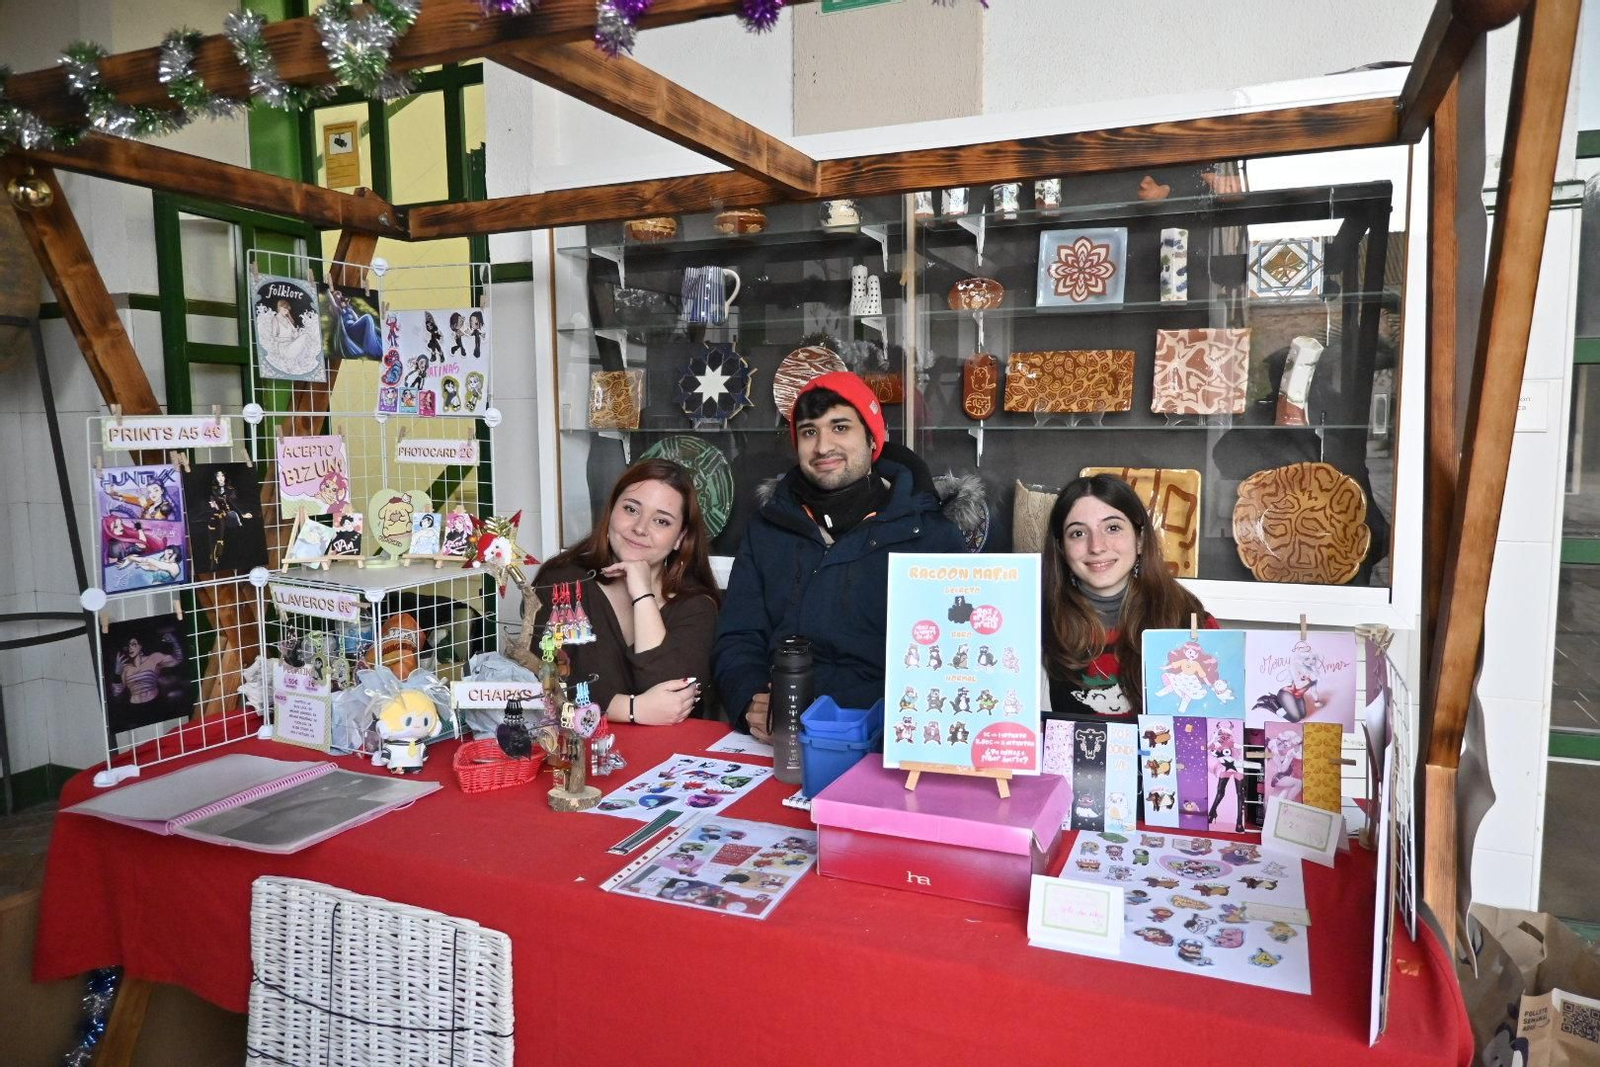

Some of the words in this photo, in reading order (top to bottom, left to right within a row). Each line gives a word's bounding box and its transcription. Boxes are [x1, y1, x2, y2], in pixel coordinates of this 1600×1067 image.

[265, 284, 304, 299] folklore
[109, 426, 173, 442] PRINTS
[178, 426, 198, 440] A5
[282, 444, 334, 458] ACEPTO
[398, 446, 457, 459] PHOTOCARD
[909, 567, 969, 580] RACOON
[274, 591, 335, 612] LLAVEROS
[1317, 656, 1349, 674] Xmas
[468, 688, 532, 701] CHAPAS
[906, 870, 932, 886] ha
